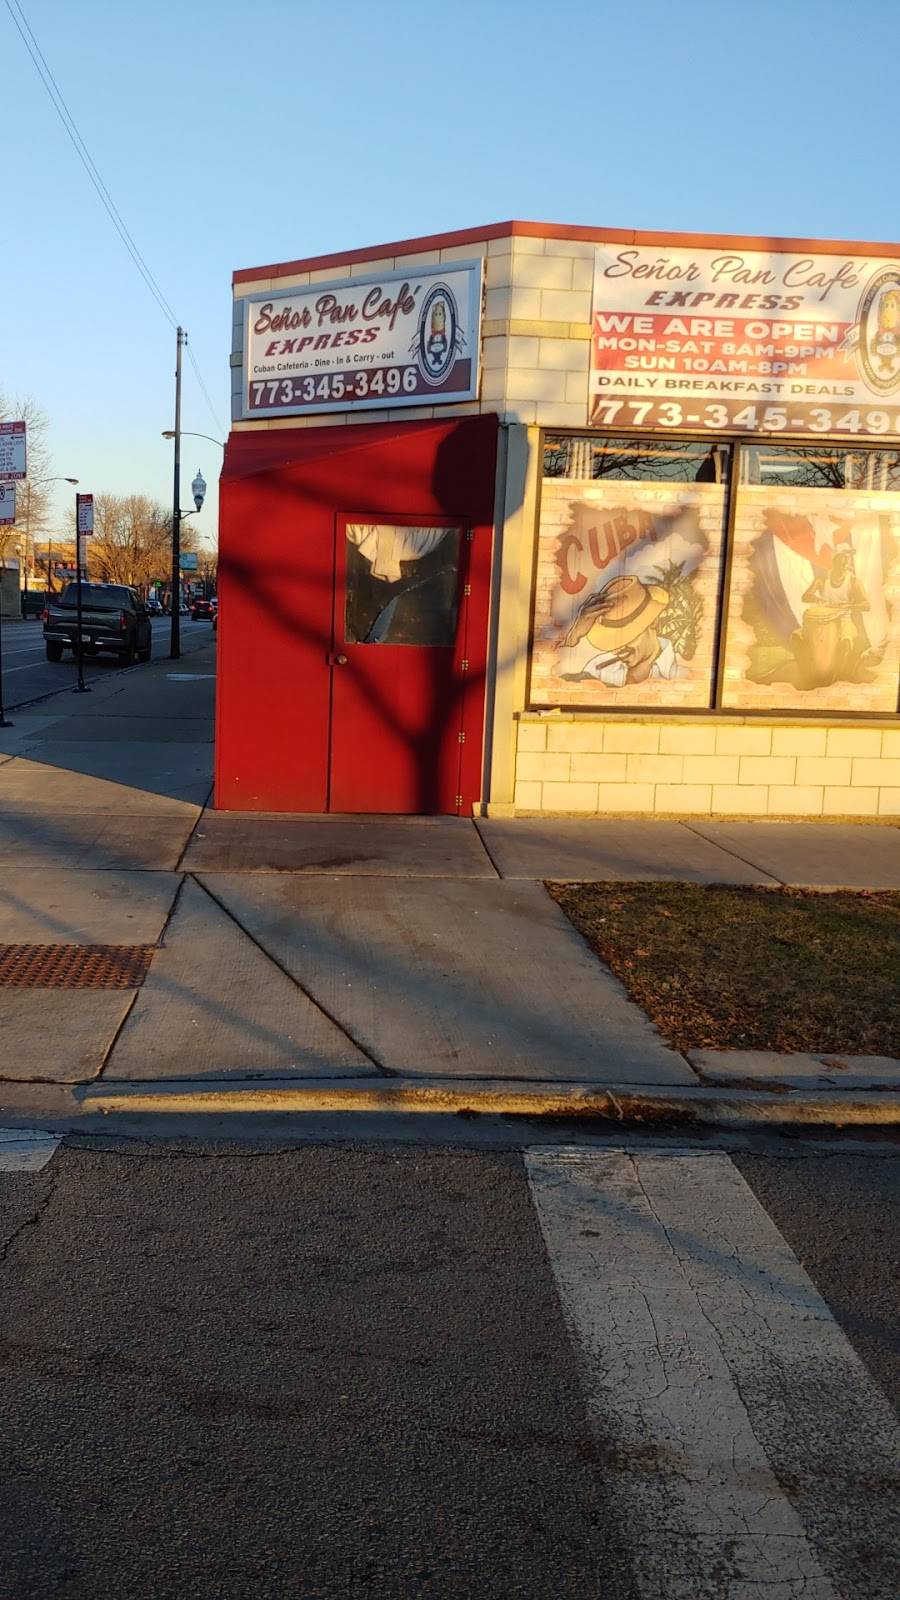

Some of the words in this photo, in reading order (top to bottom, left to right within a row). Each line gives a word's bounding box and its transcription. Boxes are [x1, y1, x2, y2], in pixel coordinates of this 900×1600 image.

[604, 251, 701, 281] Señor
[711, 255, 776, 285] Pan
[782, 259, 868, 302] Café
[254, 303, 312, 335] Señor
[315, 294, 359, 327] Pan
[362, 282, 422, 331] Café
[644, 291, 805, 310] EXPRESS
[264, 327, 381, 357] EXPRESS
[596, 314, 654, 334] WE
[662, 318, 735, 337] ARE
[744, 321, 839, 342] OPEN
[253, 365, 275, 373] Cuban
[277, 361, 309, 371] Cafeteria
[314, 359, 331, 367] Dine
[336, 356, 344, 365] In
[345, 355, 351, 363] &
[353, 353, 375, 363] Carry
[381, 351, 395, 359] out
[597, 336, 716, 354] MON-SAT
[721, 342, 835, 359] 8AM-9PM
[624, 355, 676, 370] SUN
[683, 358, 808, 375] 10AM-8PM
[252, 367, 418, 405] 773-345-3496
[597, 376, 658, 388] DAILY
[664, 379, 784, 393] BREAKFAST
[791, 384, 855, 396] DEALS
[598, 400, 900, 434] 773-345-349
[557, 507, 658, 594] CUBA
